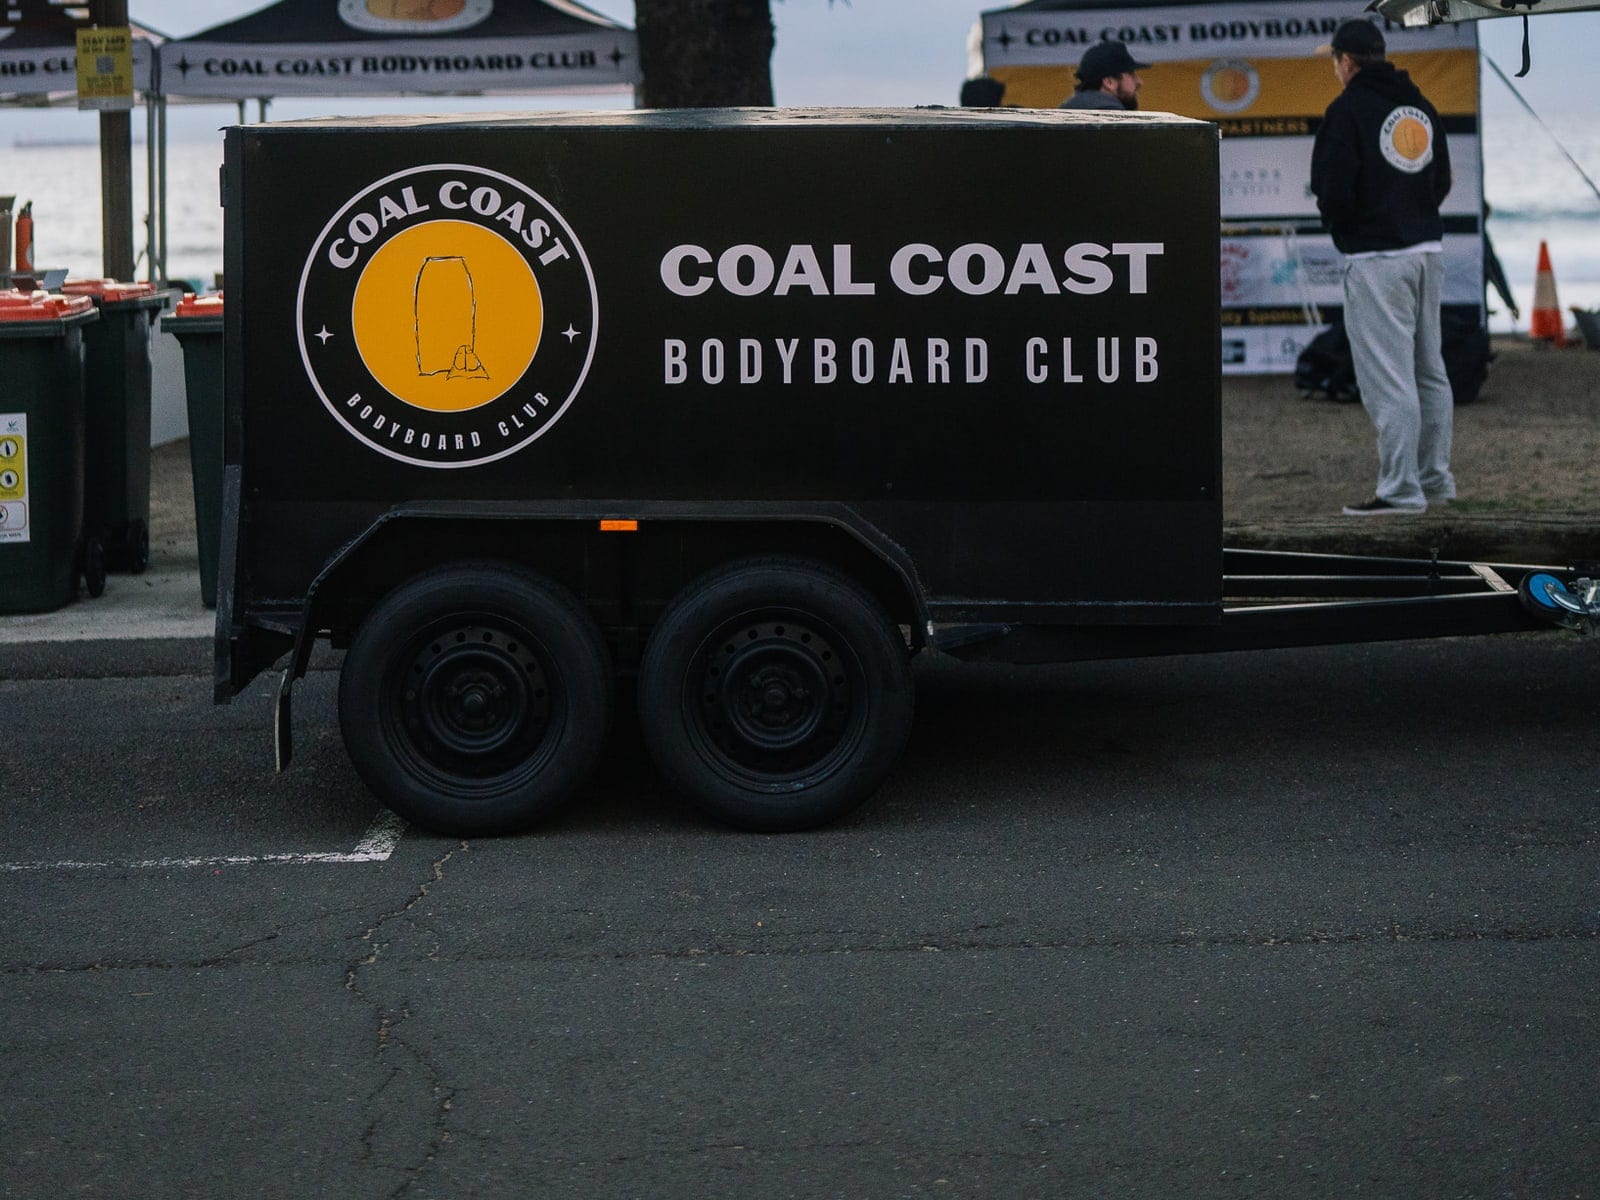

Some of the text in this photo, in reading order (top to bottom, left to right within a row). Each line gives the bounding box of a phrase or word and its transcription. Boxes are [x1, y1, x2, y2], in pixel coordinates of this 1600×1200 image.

[1025, 16, 1341, 47] COAL COAST BODYBOAR
[203, 50, 598, 77] COAL COAST BODYBOARD CLUB
[328, 180, 571, 269] COAL COAST
[660, 244, 876, 297] COAL
[889, 242, 1165, 296] COAST
[664, 336, 1159, 385] BODYBOARD CLUB
[346, 392, 549, 451] BODYBOARD CLUB
